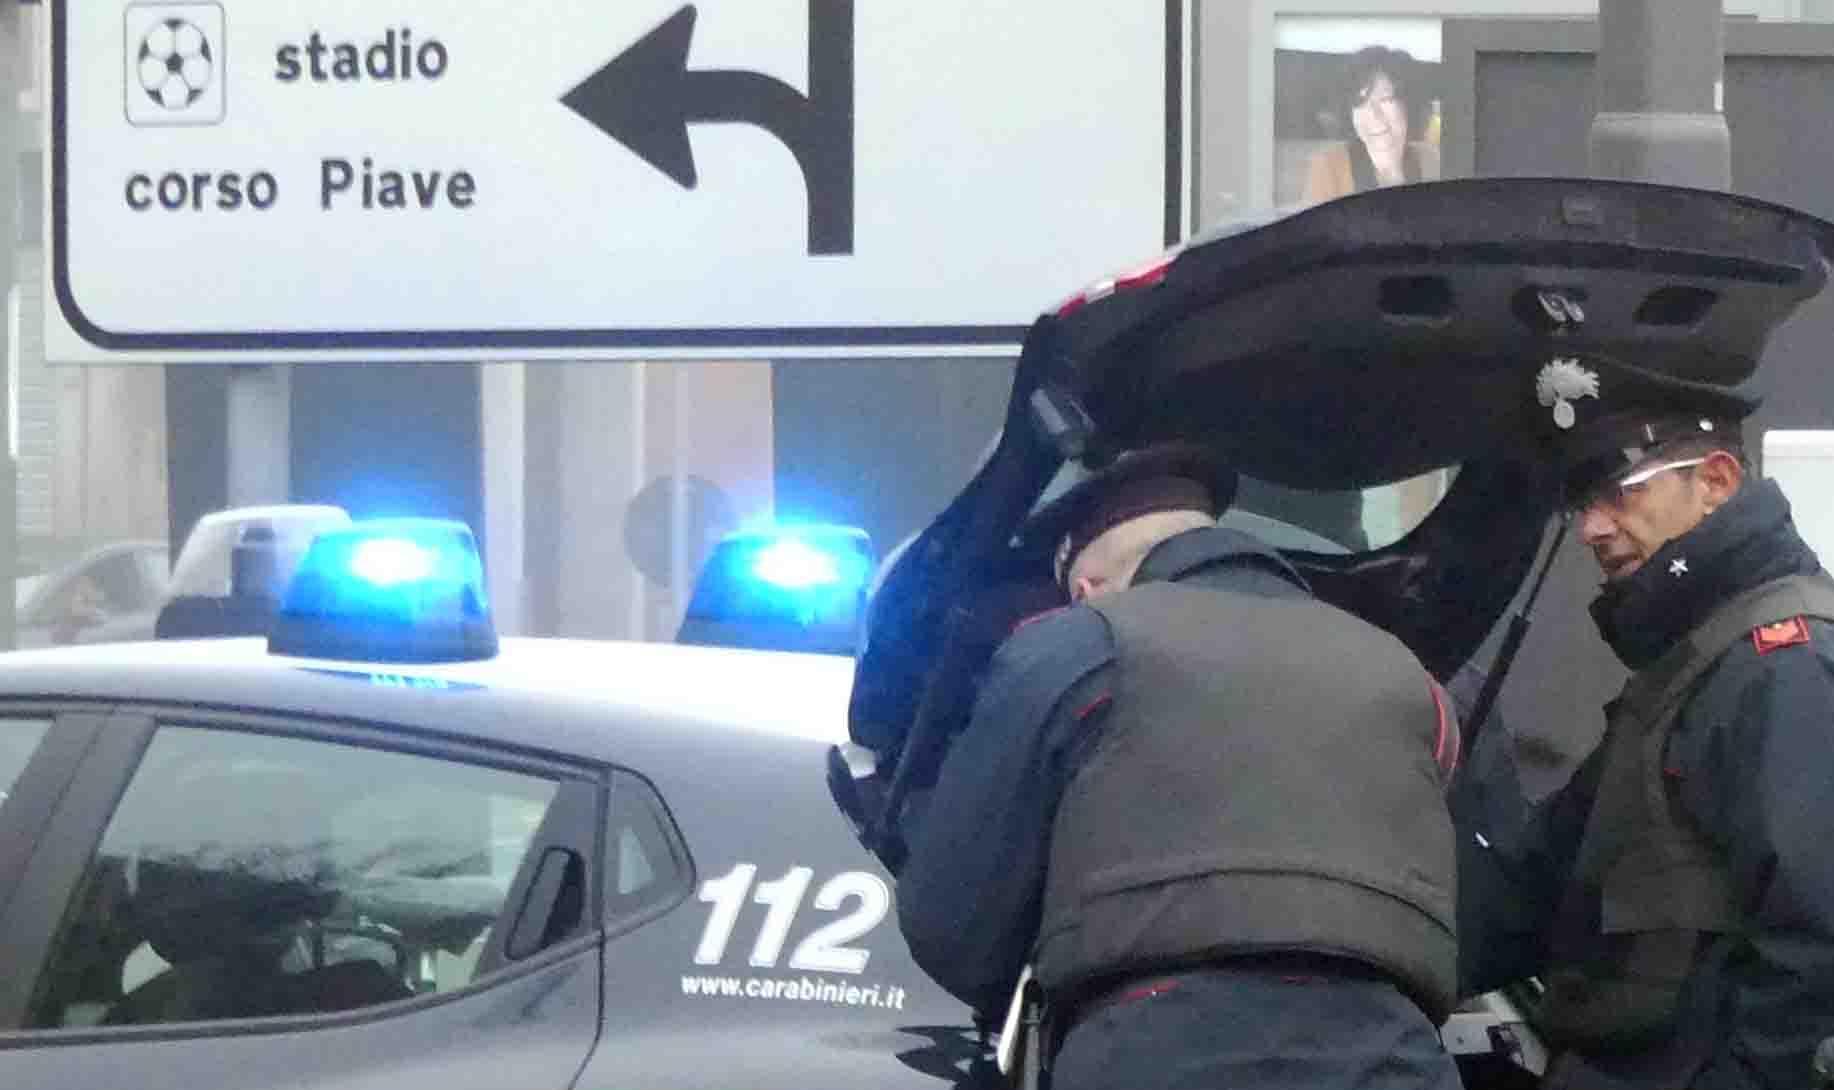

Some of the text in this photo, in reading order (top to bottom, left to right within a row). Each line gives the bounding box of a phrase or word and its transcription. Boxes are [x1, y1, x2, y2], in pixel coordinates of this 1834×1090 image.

[275, 28, 449, 82] stadio
[124, 157, 476, 211] corso Piave
[693, 863, 890, 975] 112
[680, 975, 907, 1010] www.carabinieri.it
